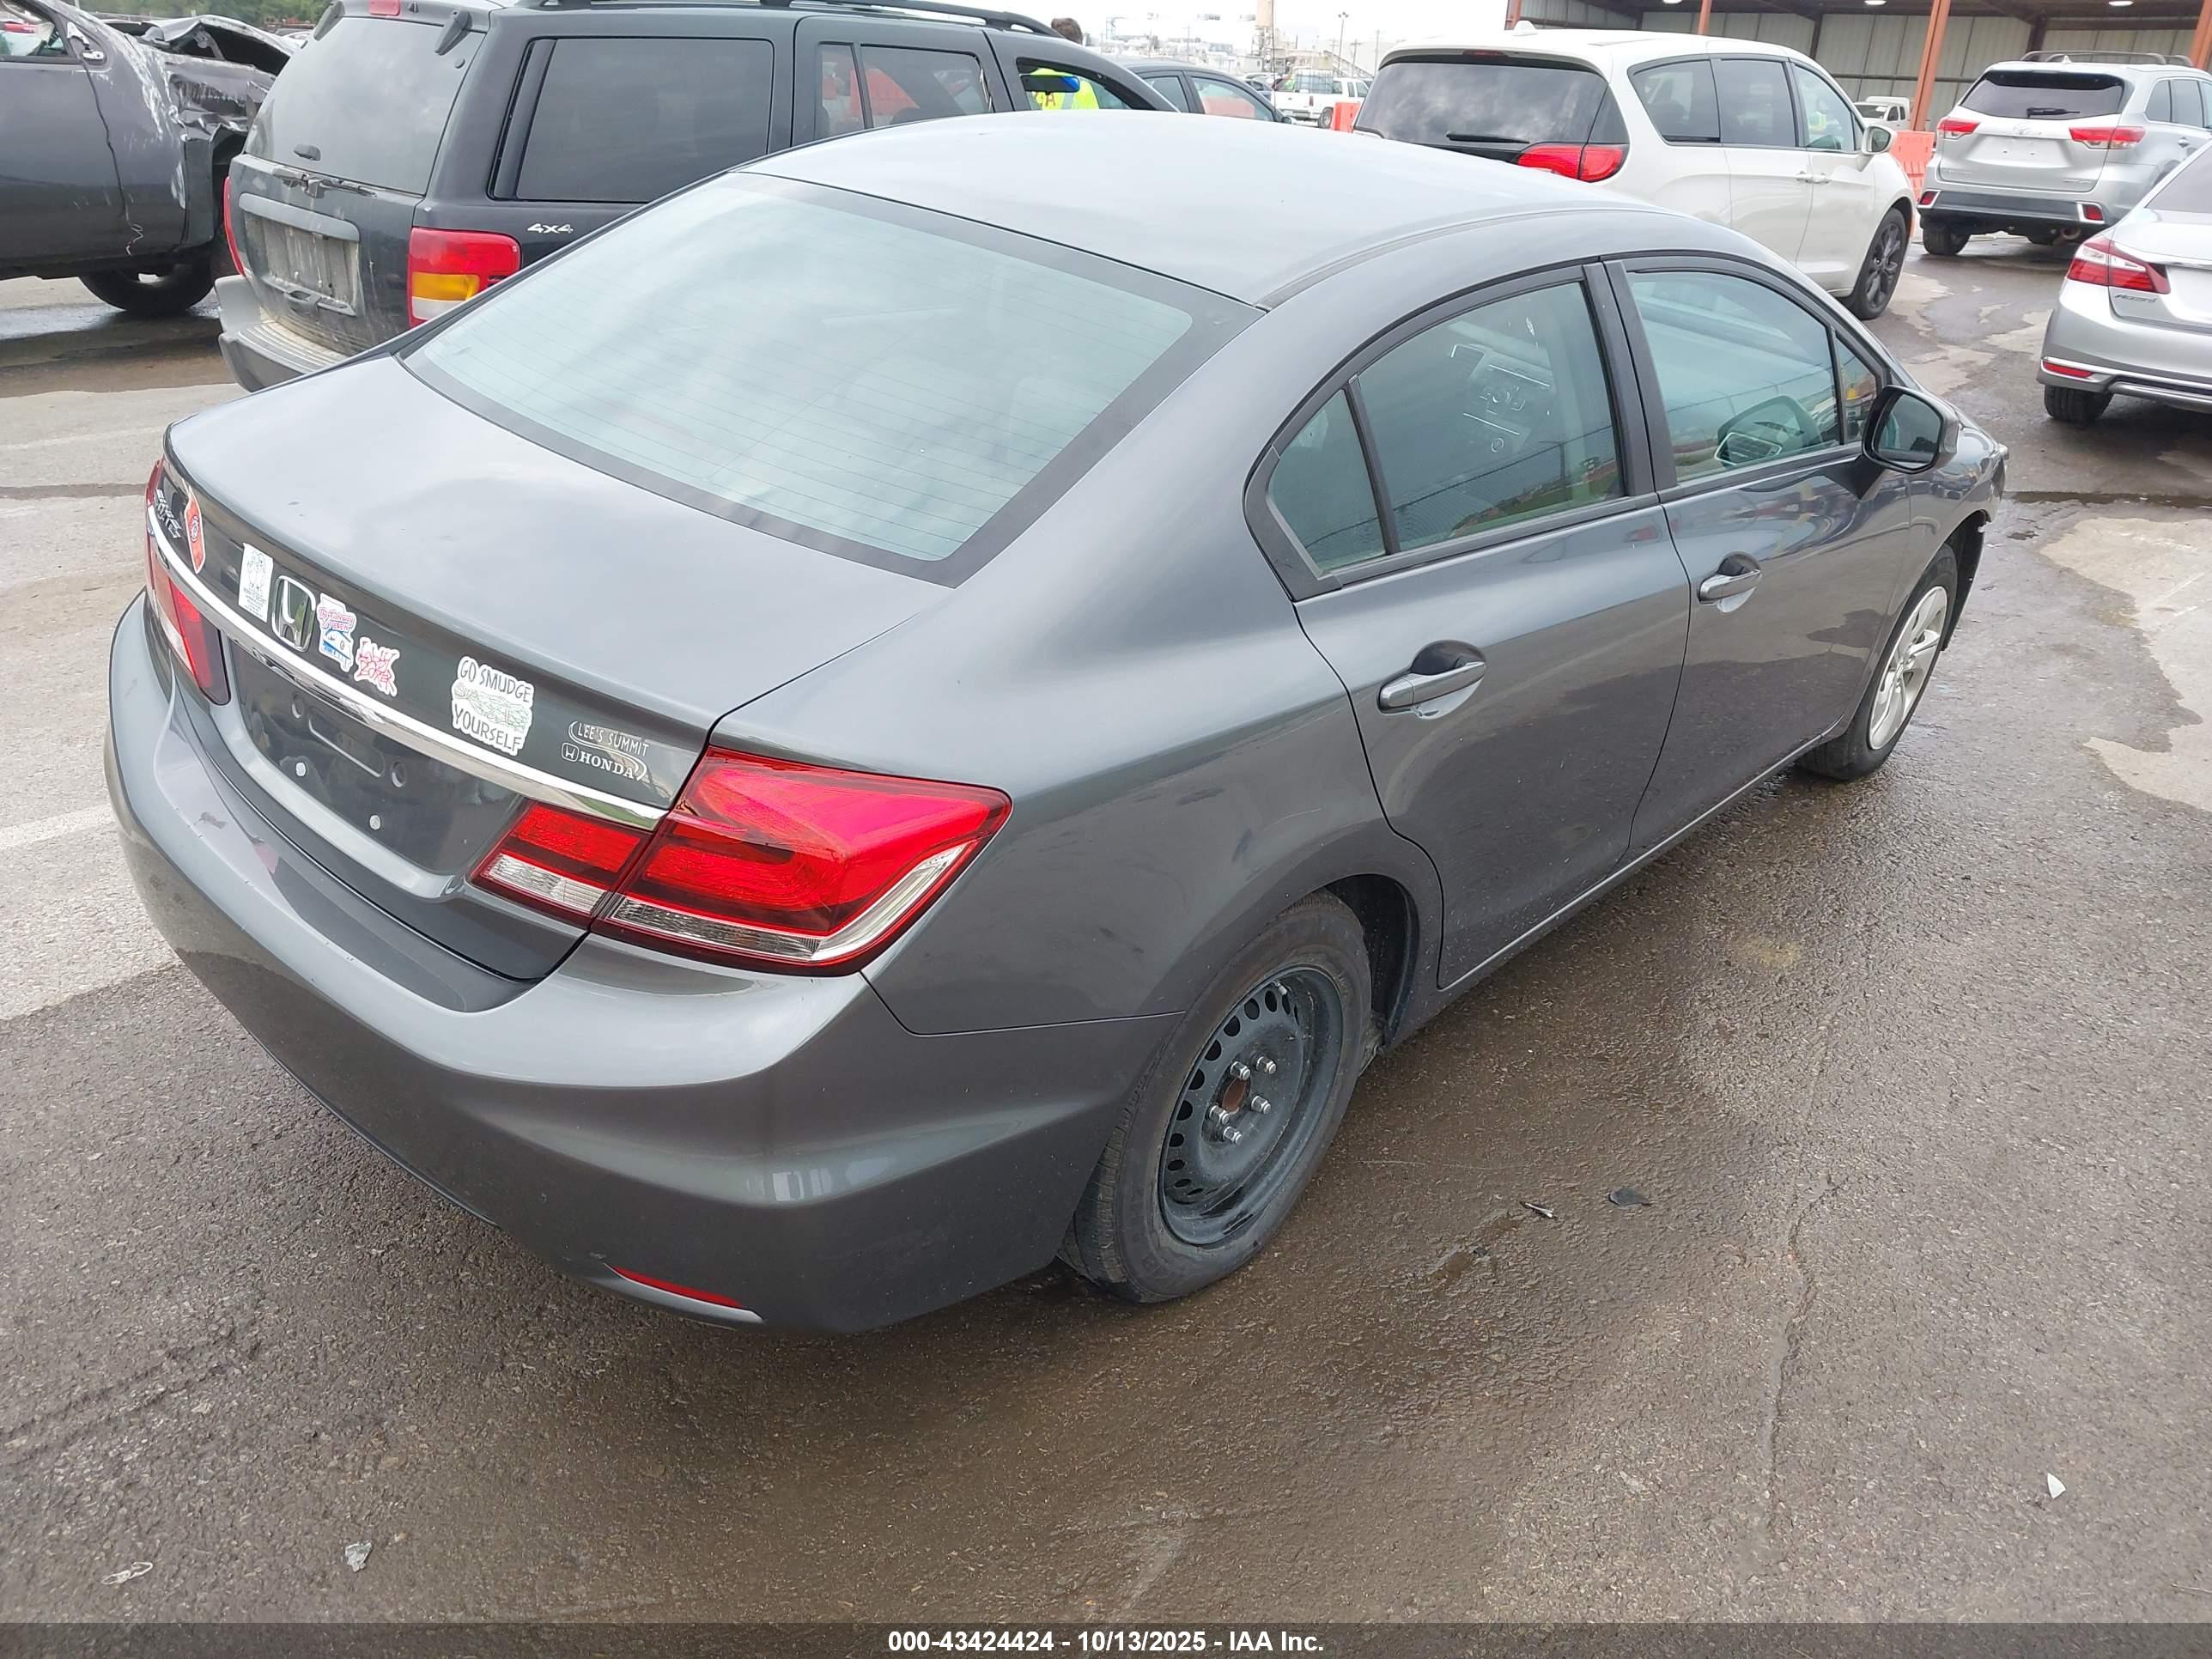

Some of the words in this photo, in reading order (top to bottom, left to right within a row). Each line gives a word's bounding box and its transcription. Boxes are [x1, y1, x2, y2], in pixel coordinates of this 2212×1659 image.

[461, 659, 477, 683] GO
[479, 668, 532, 702] SMUDGE
[454, 703, 522, 752] YOURSELF
[578, 722, 605, 743] LEE'S
[608, 732, 649, 757] SUMMIT
[579, 750, 635, 780] HONDA
